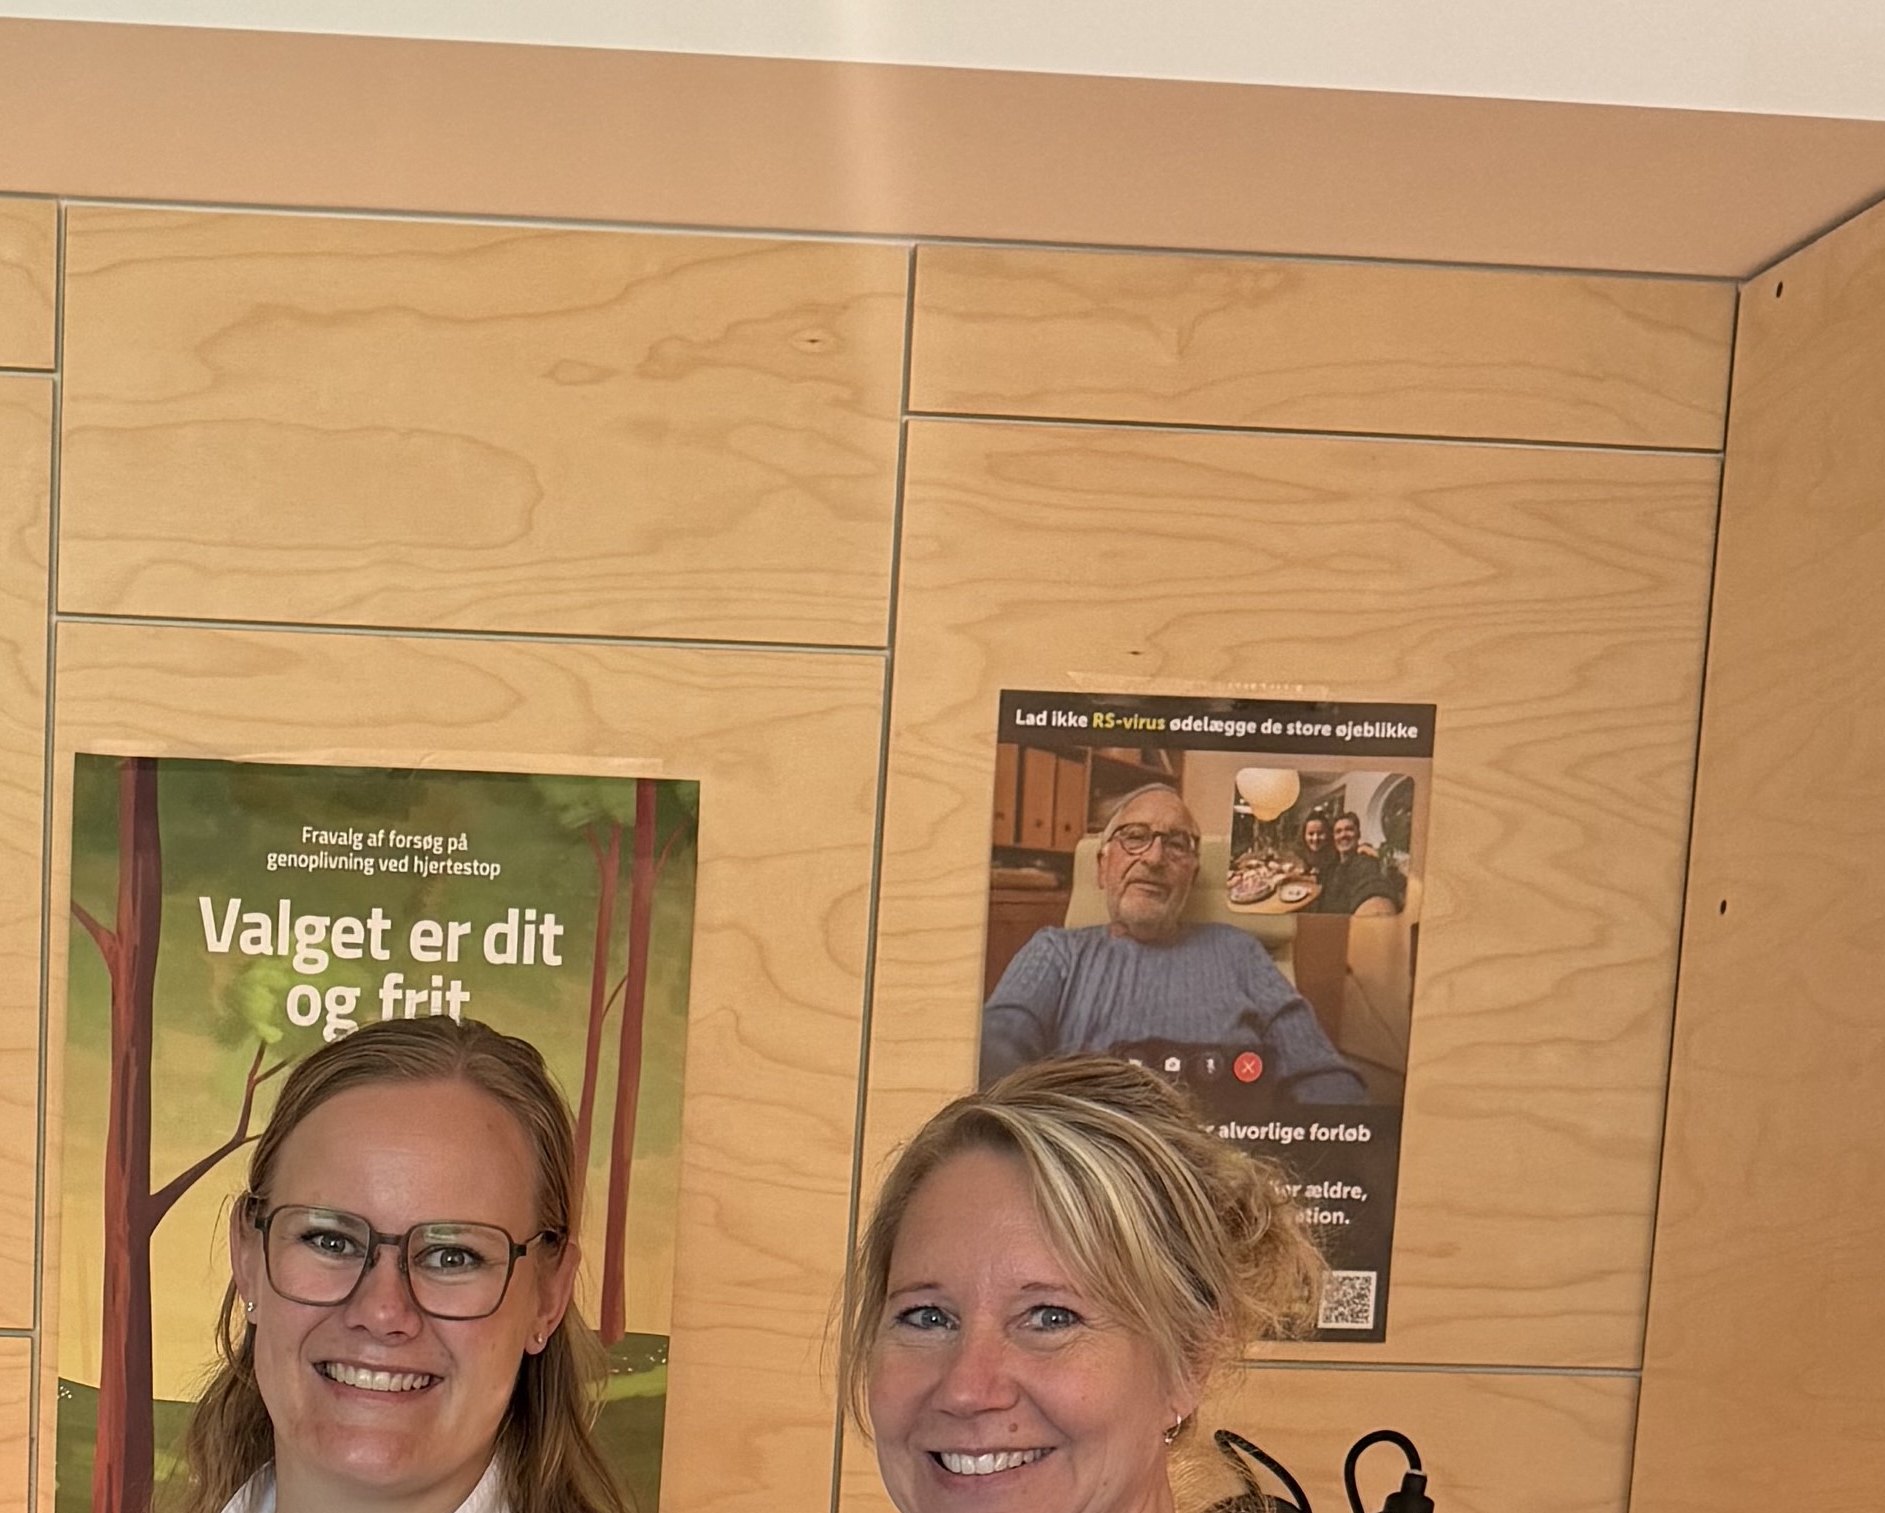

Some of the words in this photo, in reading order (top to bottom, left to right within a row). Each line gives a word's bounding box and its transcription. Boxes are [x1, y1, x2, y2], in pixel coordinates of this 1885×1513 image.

[1016, 709, 1047, 726] Lad
[1051, 710, 1088, 728] ikke
[1092, 711, 1165, 731] RS-virus
[1169, 715, 1257, 737] ødelægge
[1260, 718, 1282, 735] de
[1286, 720, 1331, 736] store
[1335, 720, 1419, 741] øjeblikke
[302, 826, 363, 850] Fravalg
[367, 829, 385, 847] af
[388, 830, 443, 854] forsøg
[447, 832, 468, 854] på
[266, 851, 374, 876] genoplivning
[378, 852, 409, 873] ved
[413, 855, 501, 880] hjertestop
[198, 896, 391, 974] Valget
[410, 919, 471, 963] er
[483, 908, 564, 966] dit
[286, 984, 361, 1042] og
[379, 972, 470, 1027] frit
[1219, 1121, 1305, 1144] alvorlige
[1309, 1122, 1372, 1142] forløb
[1305, 1181, 1367, 1202] ældre,
